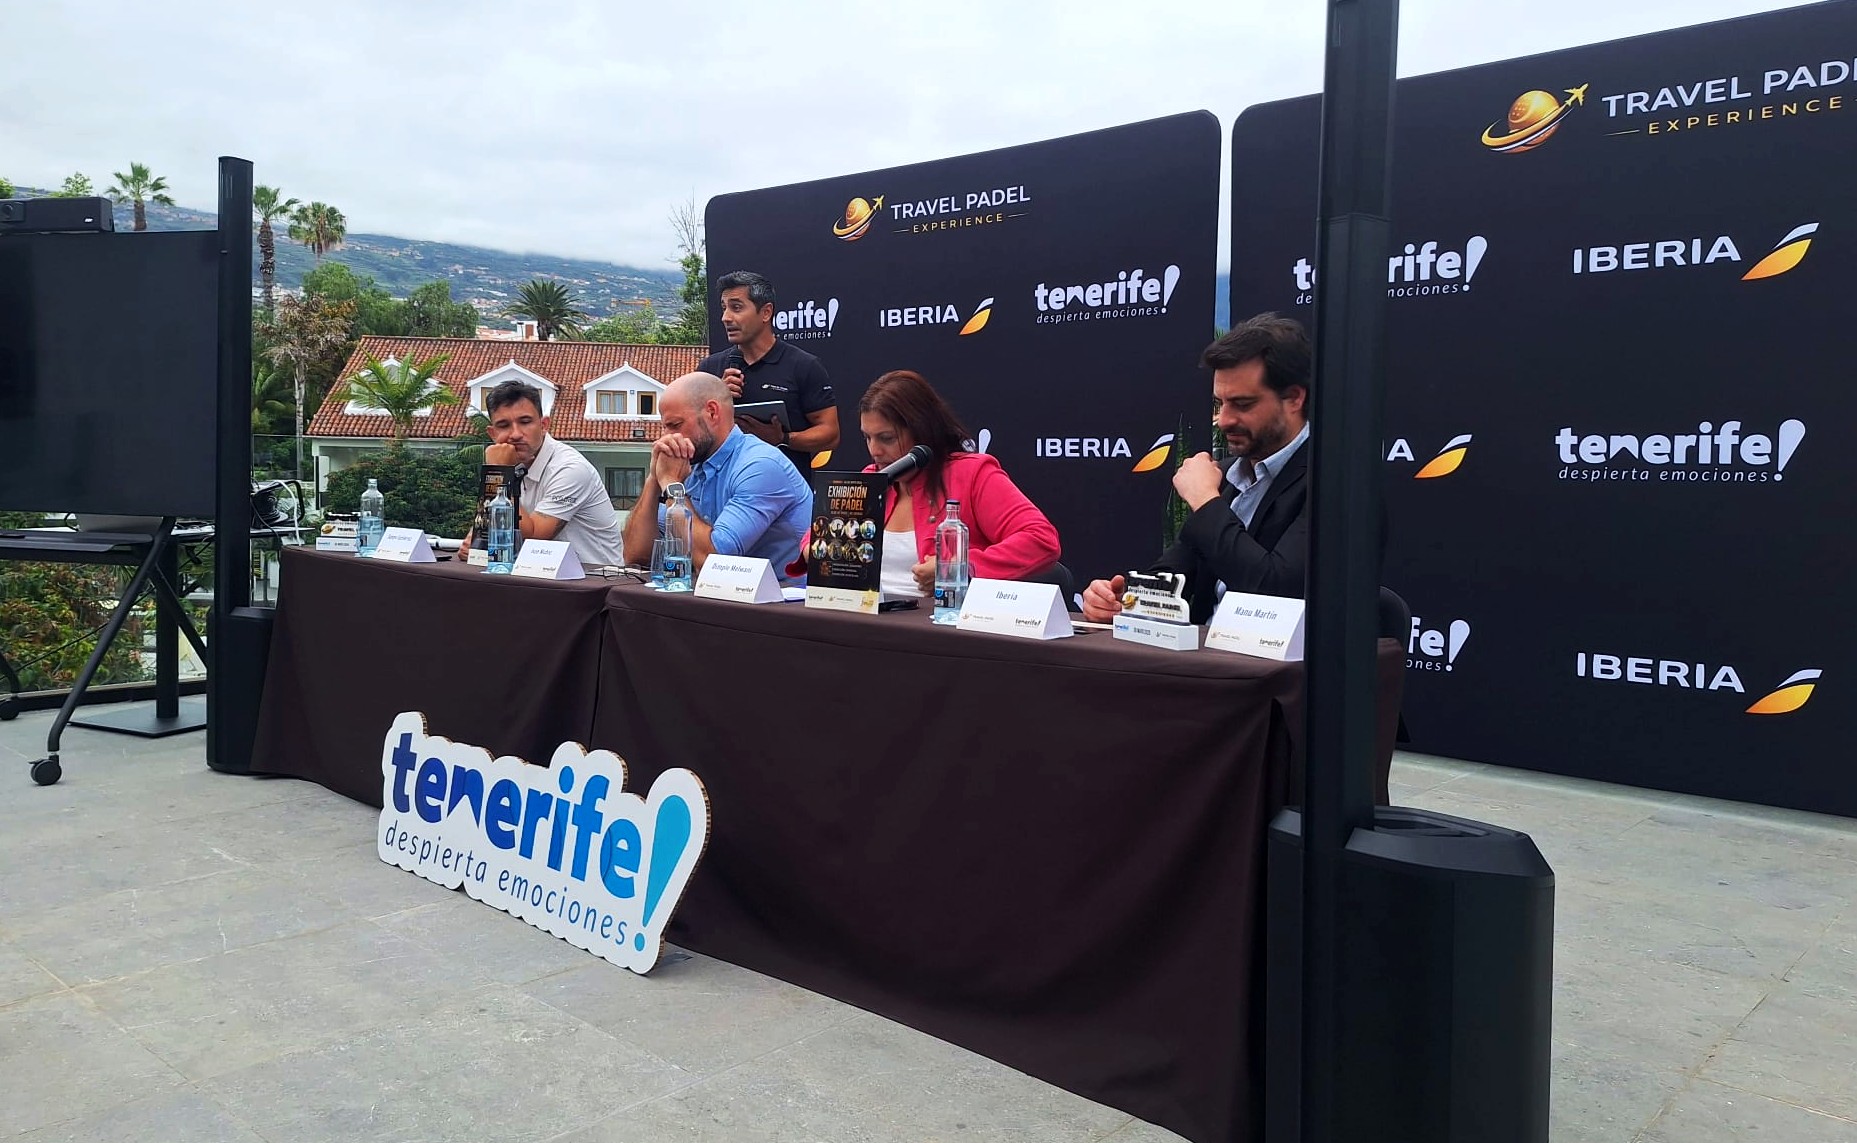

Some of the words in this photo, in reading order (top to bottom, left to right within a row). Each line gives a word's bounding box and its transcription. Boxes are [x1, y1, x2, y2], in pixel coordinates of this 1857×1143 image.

[1601, 76, 1753, 117] TRAVEL
[1648, 96, 1842, 135] EXPERIENCE
[890, 192, 962, 220] TRAVEL
[966, 185, 1031, 208] PADEL
[912, 212, 1004, 233] EXPERIENCE
[1573, 236, 1741, 274] IBERIA
[1035, 264, 1181, 314] tenerife!
[880, 304, 960, 328] IBERIA
[1036, 309, 1091, 324] despierta
[1095, 305, 1159, 320] emociones
[783, 330, 826, 340] emociones
[1036, 437, 1132, 458] IBERIA
[1555, 418, 1806, 481] tenerife!
[1558, 465, 1651, 484] despierta
[1659, 465, 1769, 482] emociones
[828, 485, 868, 498] EXHIBICIÓN
[830, 499, 841, 509] DE
[995, 591, 1018, 601] Iberia
[1234, 606, 1253, 617] Manu
[1576, 652, 1745, 693] IBERIA
[391, 732, 692, 952] tenerife!
[385, 820, 487, 882] despierta
[498, 867, 628, 946] emociones
